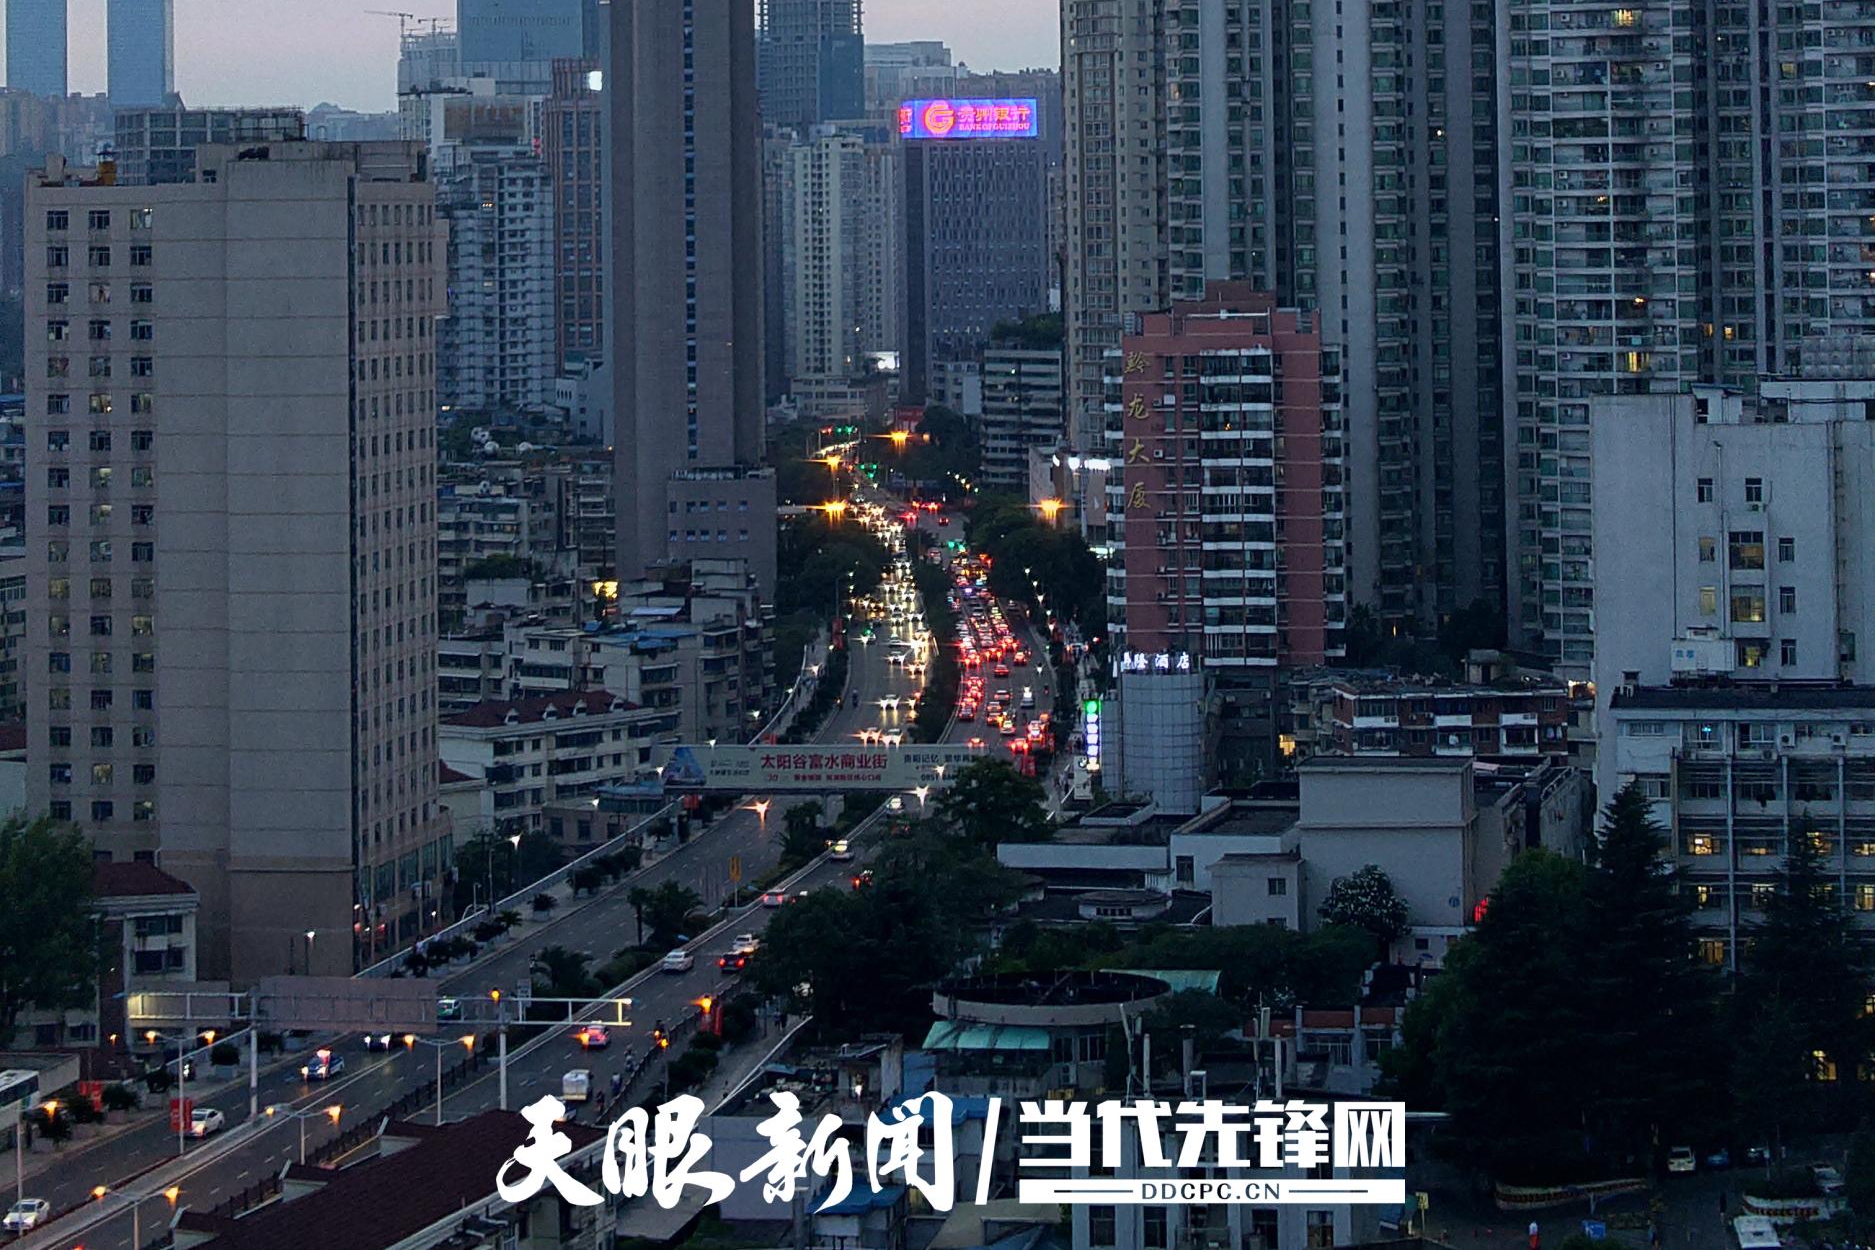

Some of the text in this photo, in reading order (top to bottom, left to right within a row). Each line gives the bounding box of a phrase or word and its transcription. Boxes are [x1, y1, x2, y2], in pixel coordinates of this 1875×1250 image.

[958, 105, 1030, 122] 贵州银行
[1125, 351, 1151, 508] 黔龙大厦
